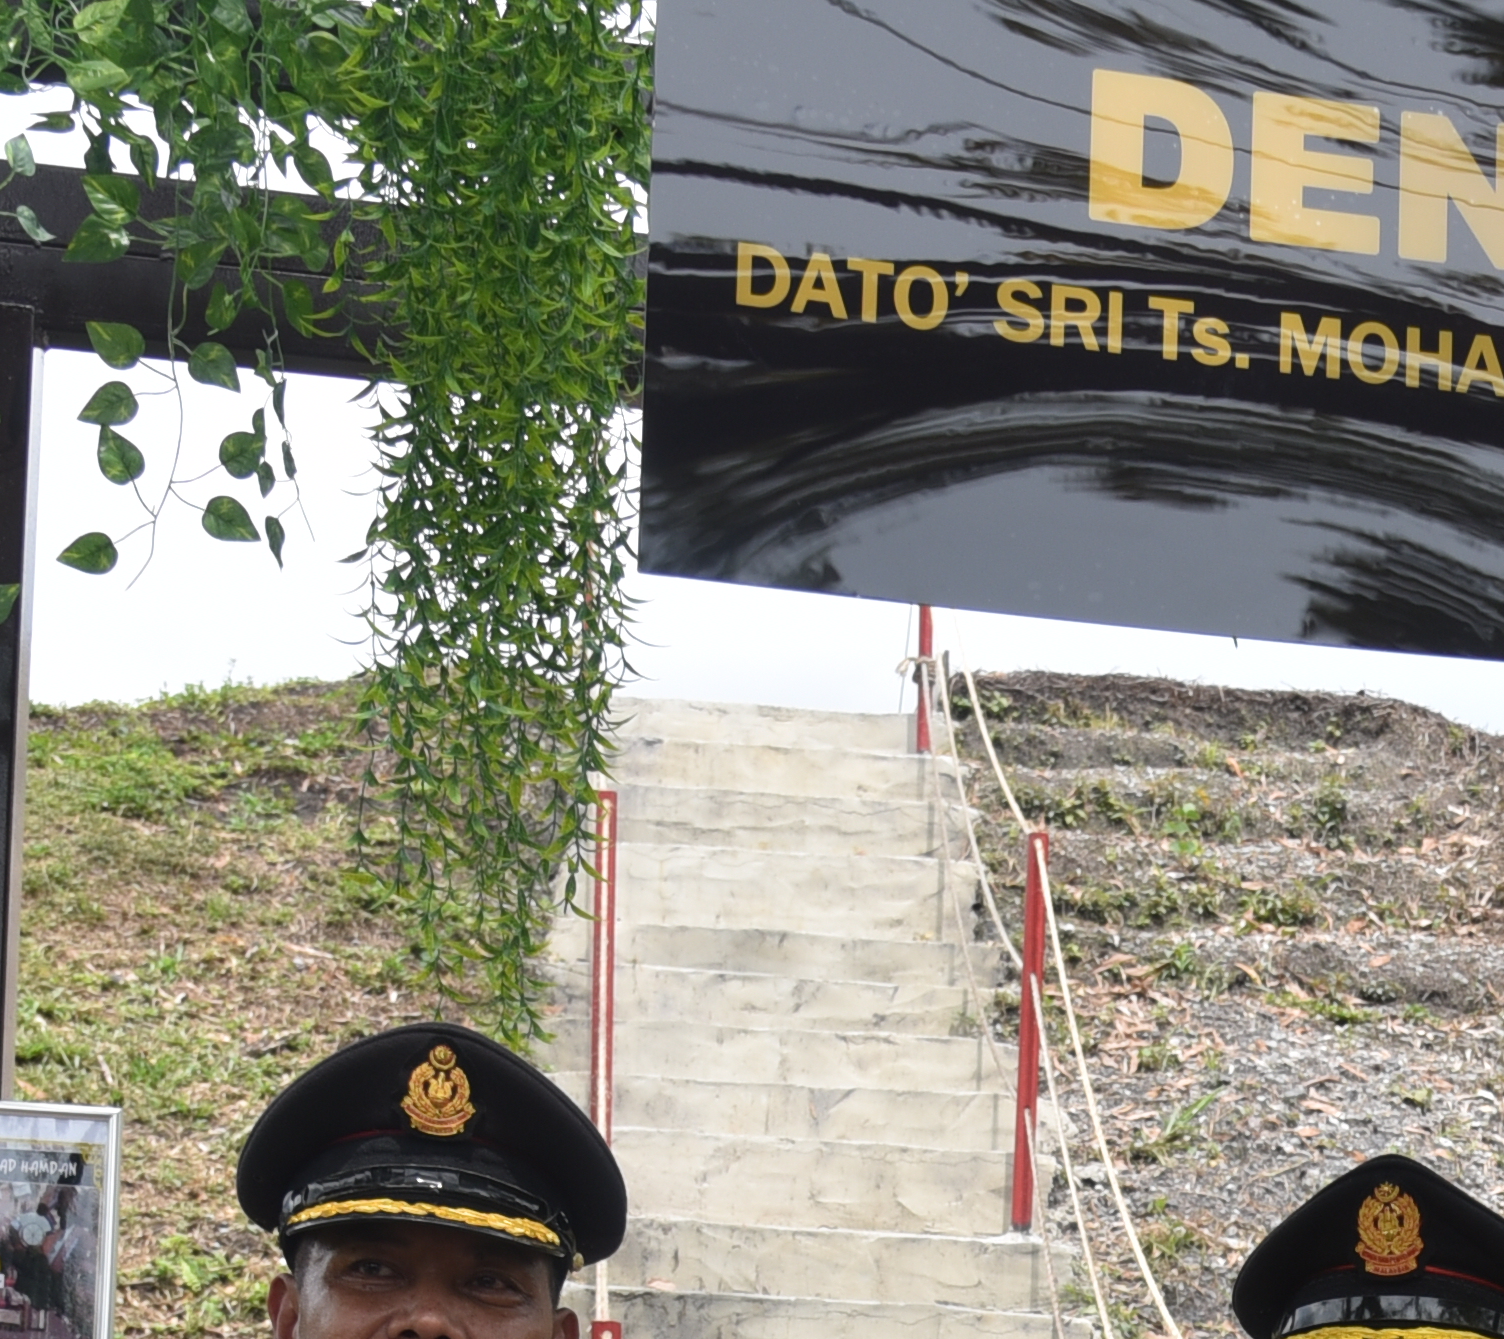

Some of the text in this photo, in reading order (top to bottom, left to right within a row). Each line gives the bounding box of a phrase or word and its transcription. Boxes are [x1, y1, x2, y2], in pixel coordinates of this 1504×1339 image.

[735, 241, 971, 332] DATO'
[993, 279, 1124, 354] SRI
[1147, 296, 1252, 371] Ts.
[21, 1159, 77, 1178] HAMDAN
